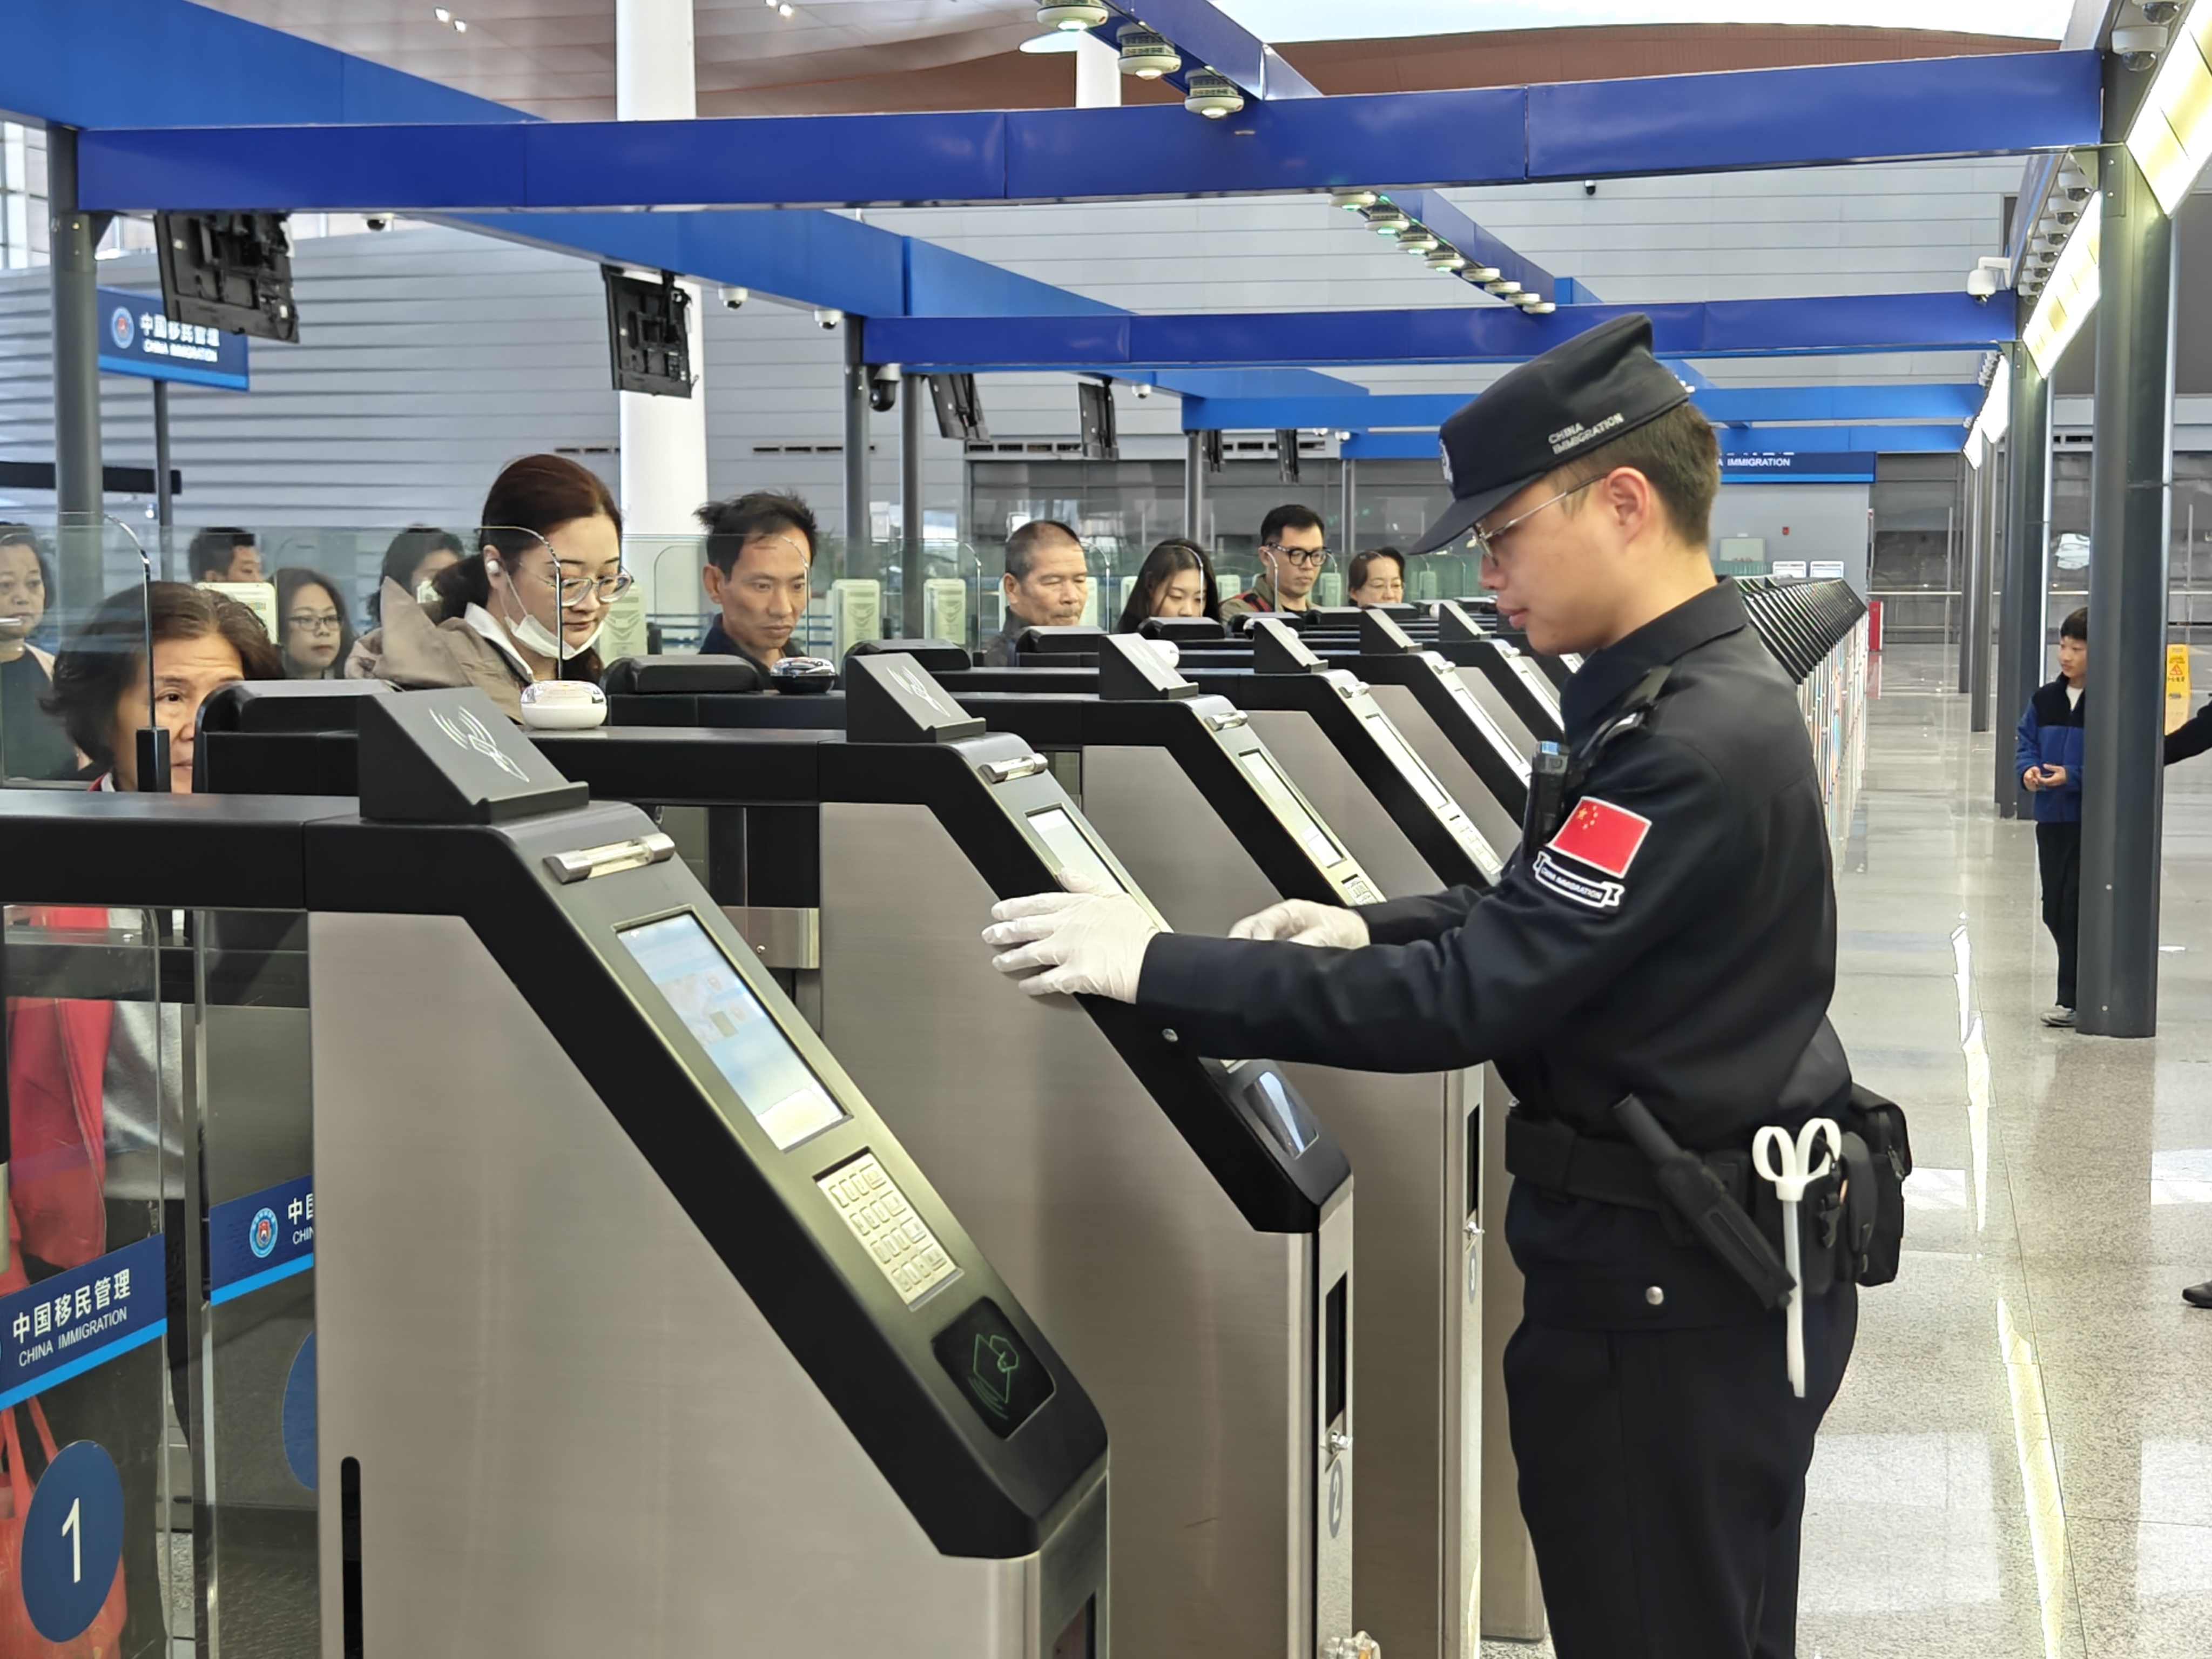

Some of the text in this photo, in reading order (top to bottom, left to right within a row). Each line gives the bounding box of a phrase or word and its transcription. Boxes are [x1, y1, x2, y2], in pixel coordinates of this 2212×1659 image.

[1548, 422, 1584, 444] CHINA
[1552, 413, 1624, 455] IMMIGRATION
[1727, 458, 1790, 467] IMMIGRATION
[13, 1269, 131, 1344] 中国移民管理
[19, 1306, 127, 1367] CHINA IMMIGRATION
[1332, 1471, 1340, 1524] 2
[62, 1497, 81, 1583] 1
